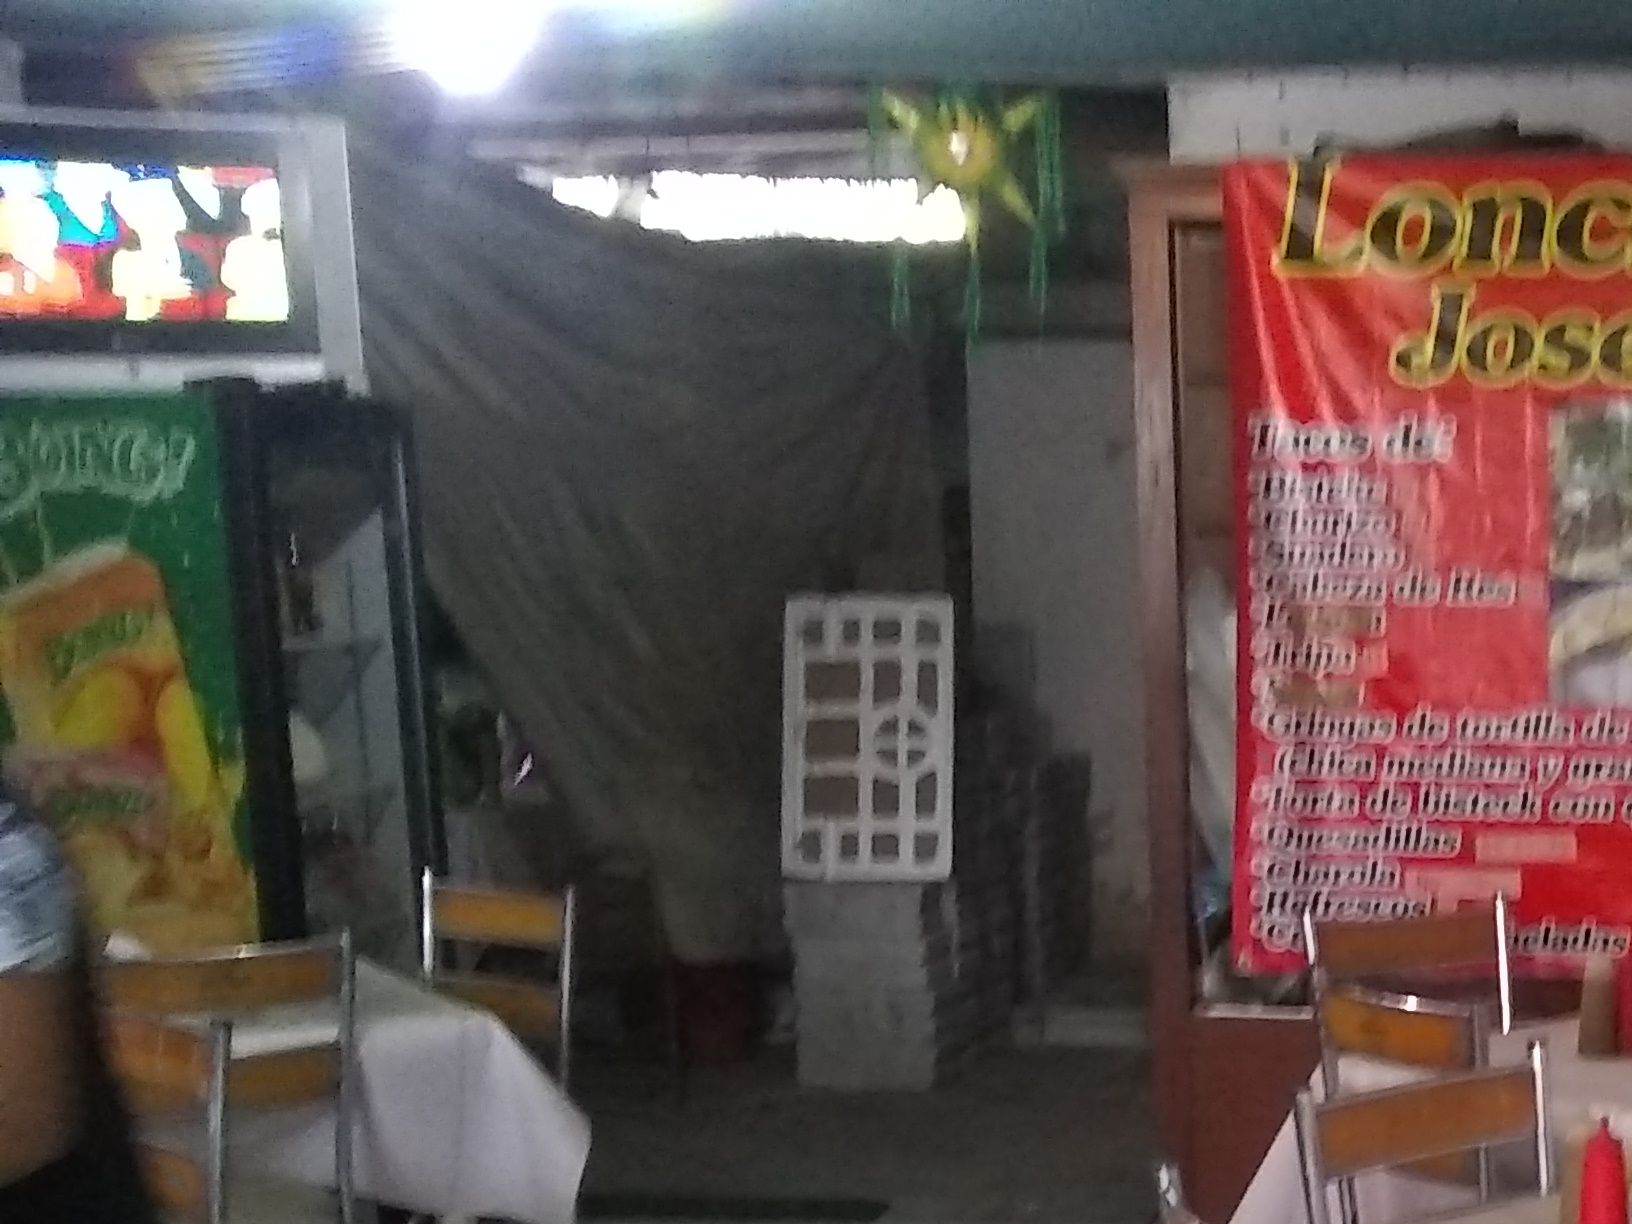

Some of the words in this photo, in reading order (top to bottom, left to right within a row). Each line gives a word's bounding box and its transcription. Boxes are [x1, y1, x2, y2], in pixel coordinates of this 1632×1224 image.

[1402, 702, 1450, 745] de
[1581, 708, 1630, 748] de
[1537, 752, 1565, 792] y
[1365, 776, 1412, 820] de
[1549, 788, 1616, 824] con
